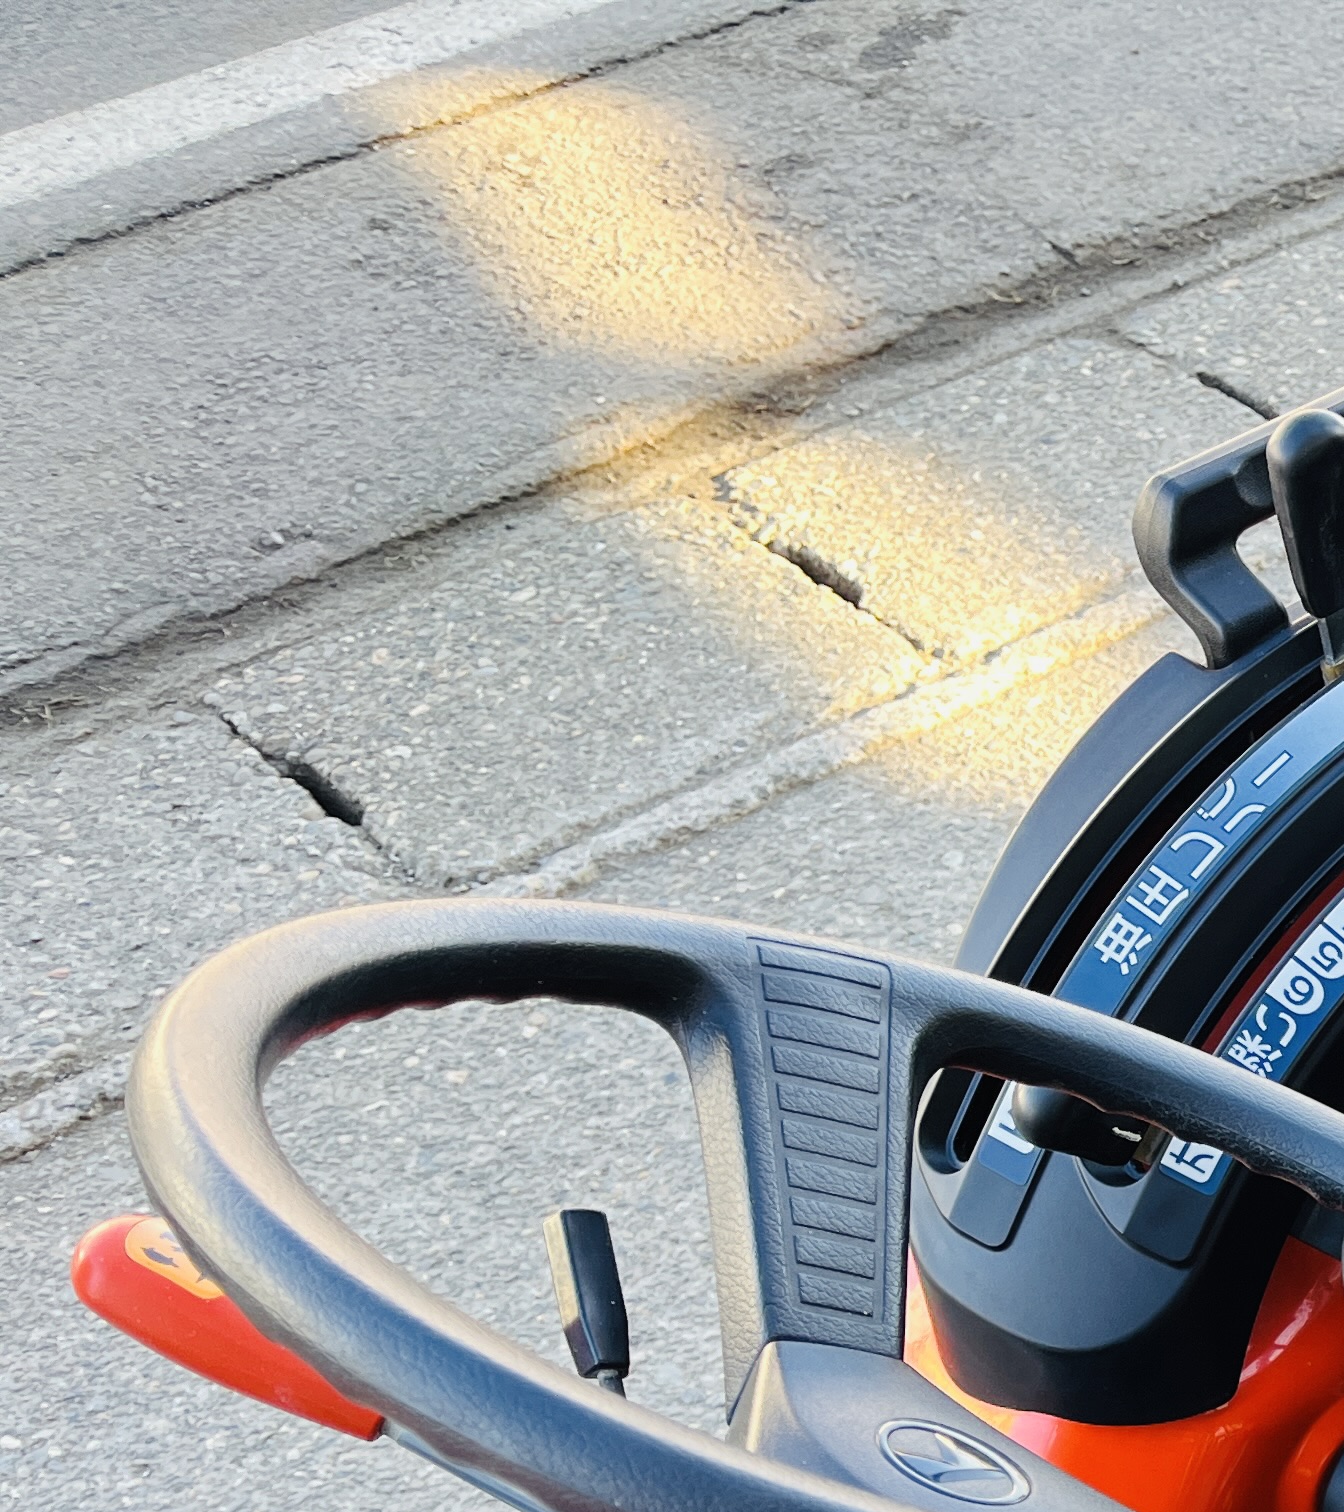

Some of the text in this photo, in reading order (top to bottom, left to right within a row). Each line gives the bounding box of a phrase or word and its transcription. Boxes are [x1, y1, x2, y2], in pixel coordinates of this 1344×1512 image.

[1095, 749, 1291, 976] 油圧レバー
[1311, 941, 1343, 973] 5
